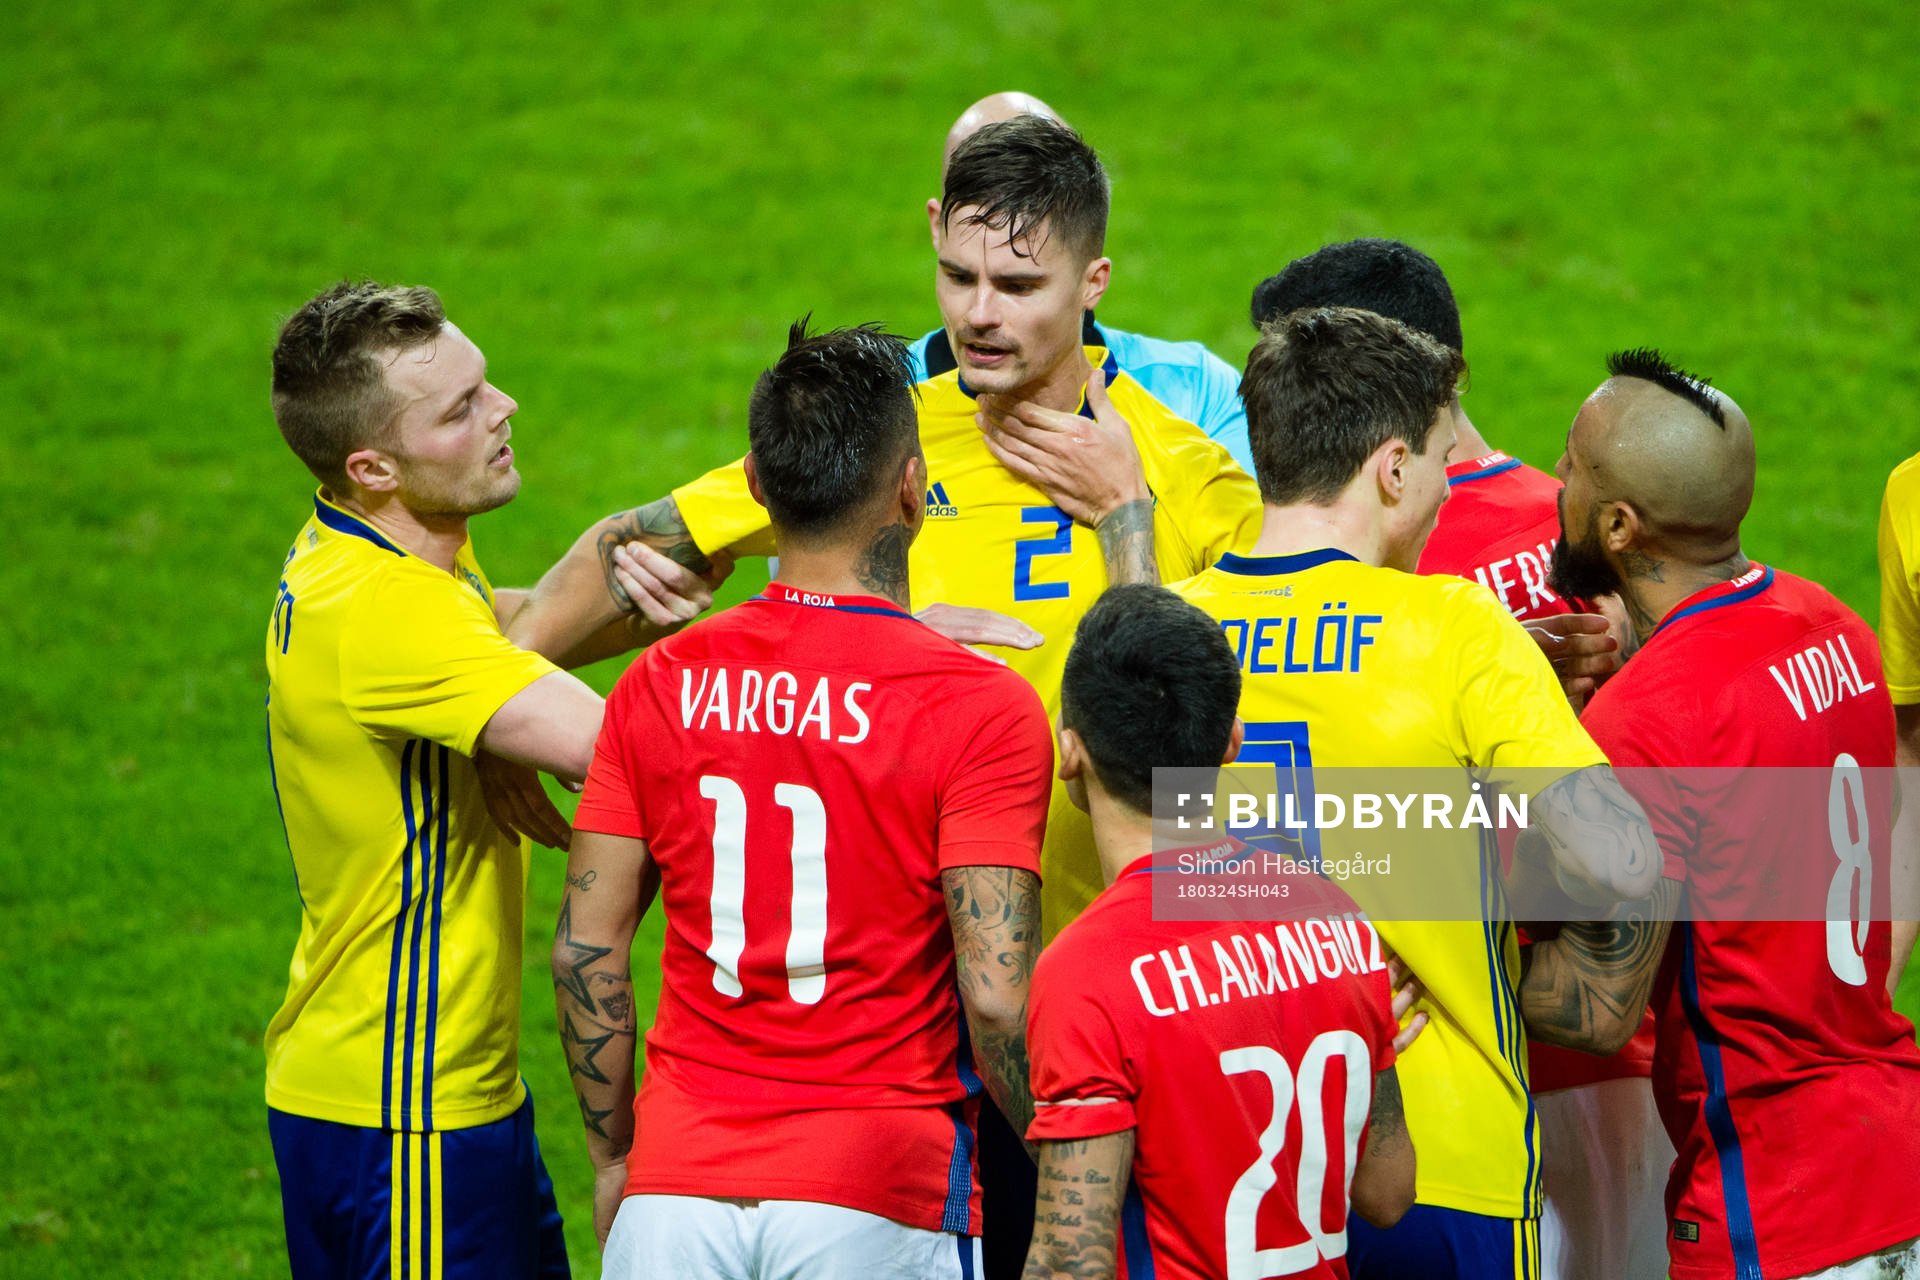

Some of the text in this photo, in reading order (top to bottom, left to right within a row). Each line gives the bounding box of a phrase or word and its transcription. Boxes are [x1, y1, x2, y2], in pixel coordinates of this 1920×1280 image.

[784, 588, 836, 607] LA ROJA
[1014, 506, 1074, 602] 2
[681, 667, 872, 744] VARGAS
[1768, 633, 1876, 721] VIDAL
[699, 775, 828, 1006] 11
[1826, 752, 1873, 986] 8
[1130, 911, 1387, 1017] CH.ARANGUIZ
[1219, 1029, 1372, 1280] 20
